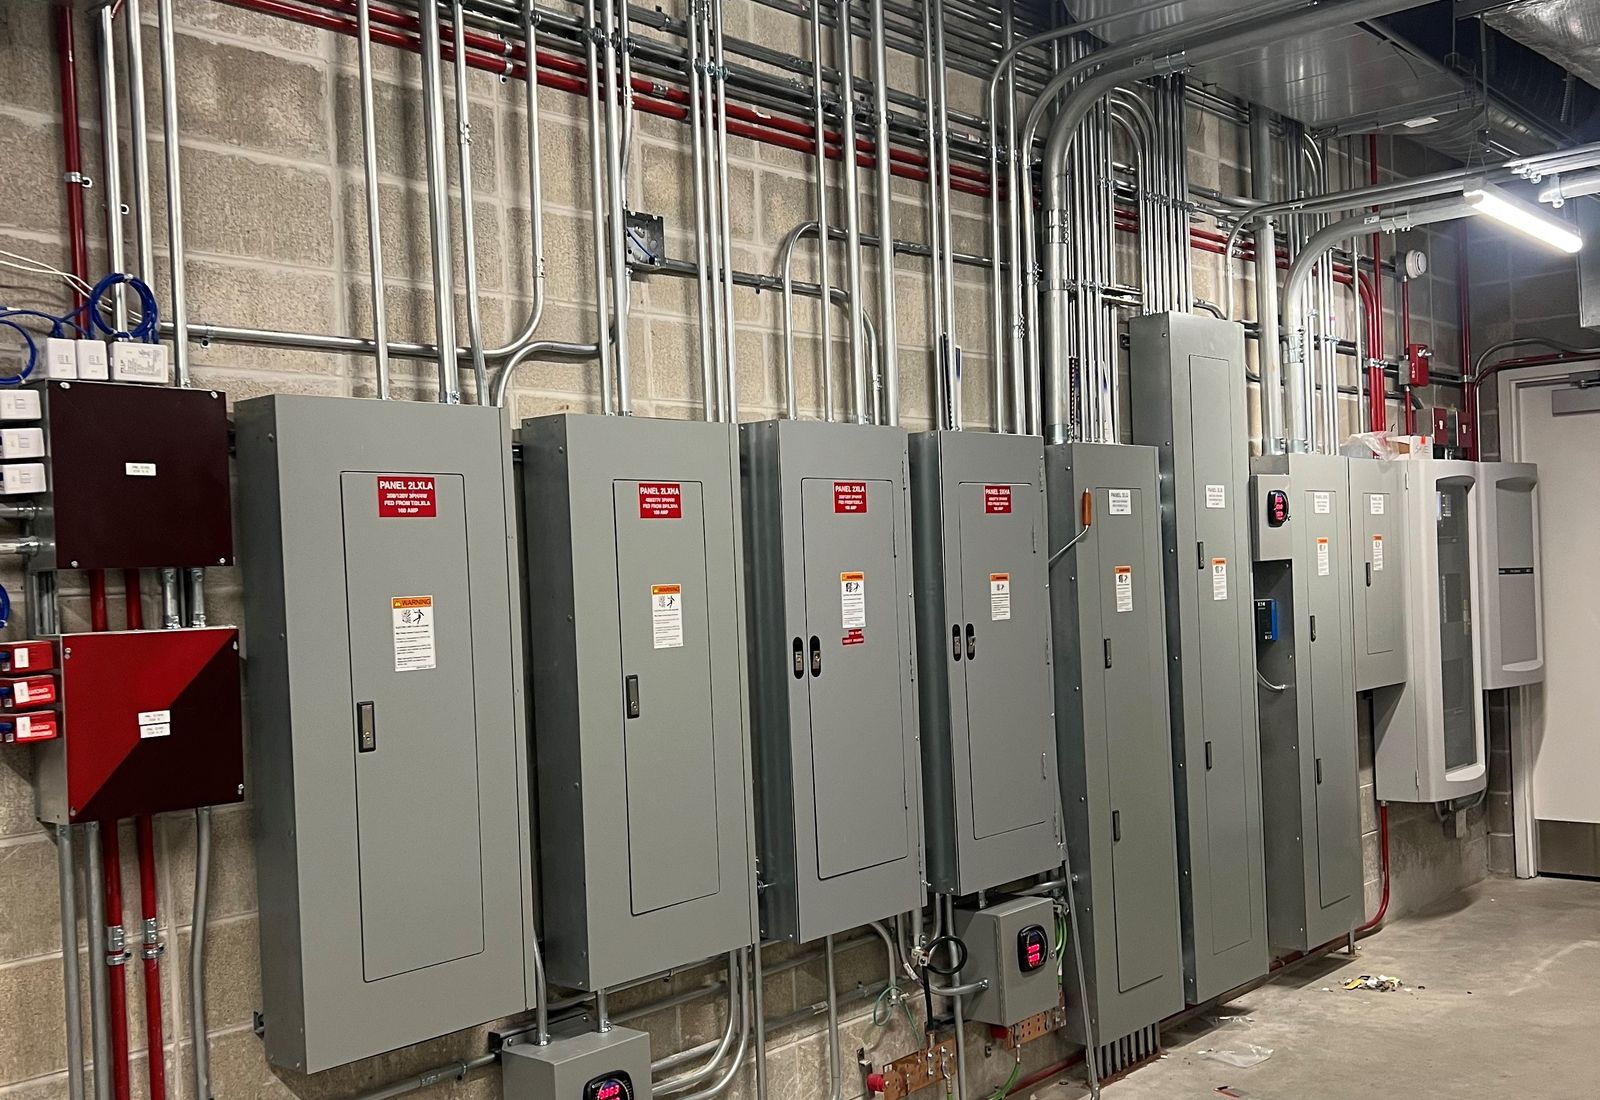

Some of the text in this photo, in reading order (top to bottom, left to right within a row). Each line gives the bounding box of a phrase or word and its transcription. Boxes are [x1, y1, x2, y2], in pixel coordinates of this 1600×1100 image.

[379, 481, 433, 490] PANEL 2LXLA
[835, 485, 852, 493] PANEL
[640, 486, 660, 495] PANEL
[401, 598, 431, 606] WARNING
